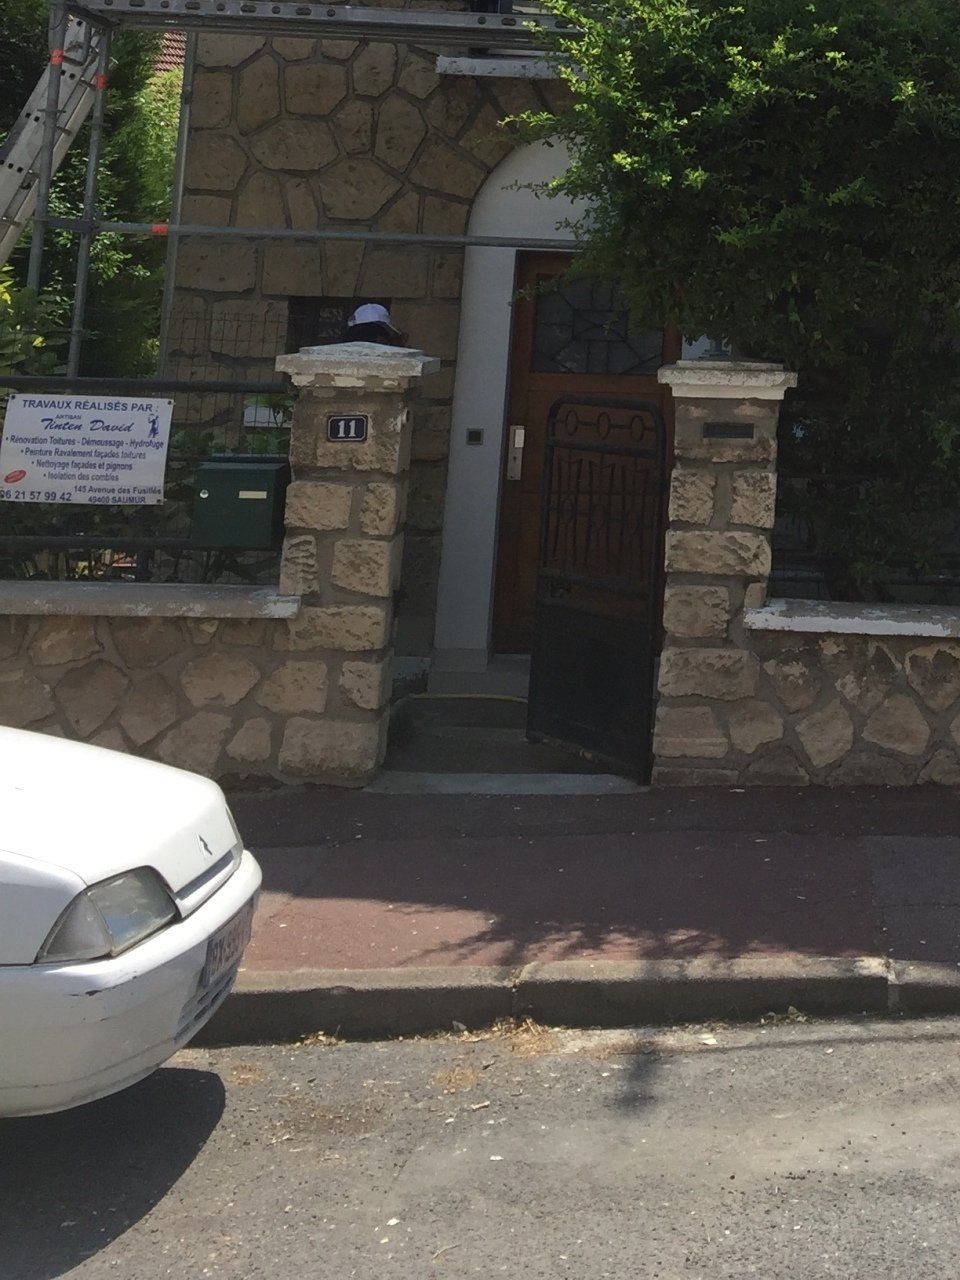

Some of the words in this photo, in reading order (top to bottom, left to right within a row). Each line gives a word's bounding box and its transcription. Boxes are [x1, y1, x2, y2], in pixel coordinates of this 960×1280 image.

[22, 399, 72, 410] TRAVAUX
[74, 400, 129, 412] RÉALISÉS
[130, 403, 153, 412] PAR
[40, 418, 83, 431] Tinten
[89, 419, 135, 432] David
[337, 419, 357, 438] 11
[10, 435, 48, 445] Rénovation
[49, 436, 76, 446] Toitures
[129, 439, 164, 450] Hydrofuge
[24, 447, 53, 457] Peinture
[54, 448, 93, 458] Ravalement
[36, 459, 70, 470] Nettoyage
[106, 463, 133, 472] pignons
[47, 472, 76, 480] Isolation
[77, 472, 90, 481] des
[90, 473, 119, 482] combles
[14, 490, 26, 500] 21
[29, 490, 42, 501] 57
[44, 491, 57, 502] 99
[59, 492, 72, 502] 42
[74, 485, 87, 493] 145
[88, 486, 116, 494] Avenue
[117, 486, 132, 495] des
[111, 496, 146, 504] SAUMUR
